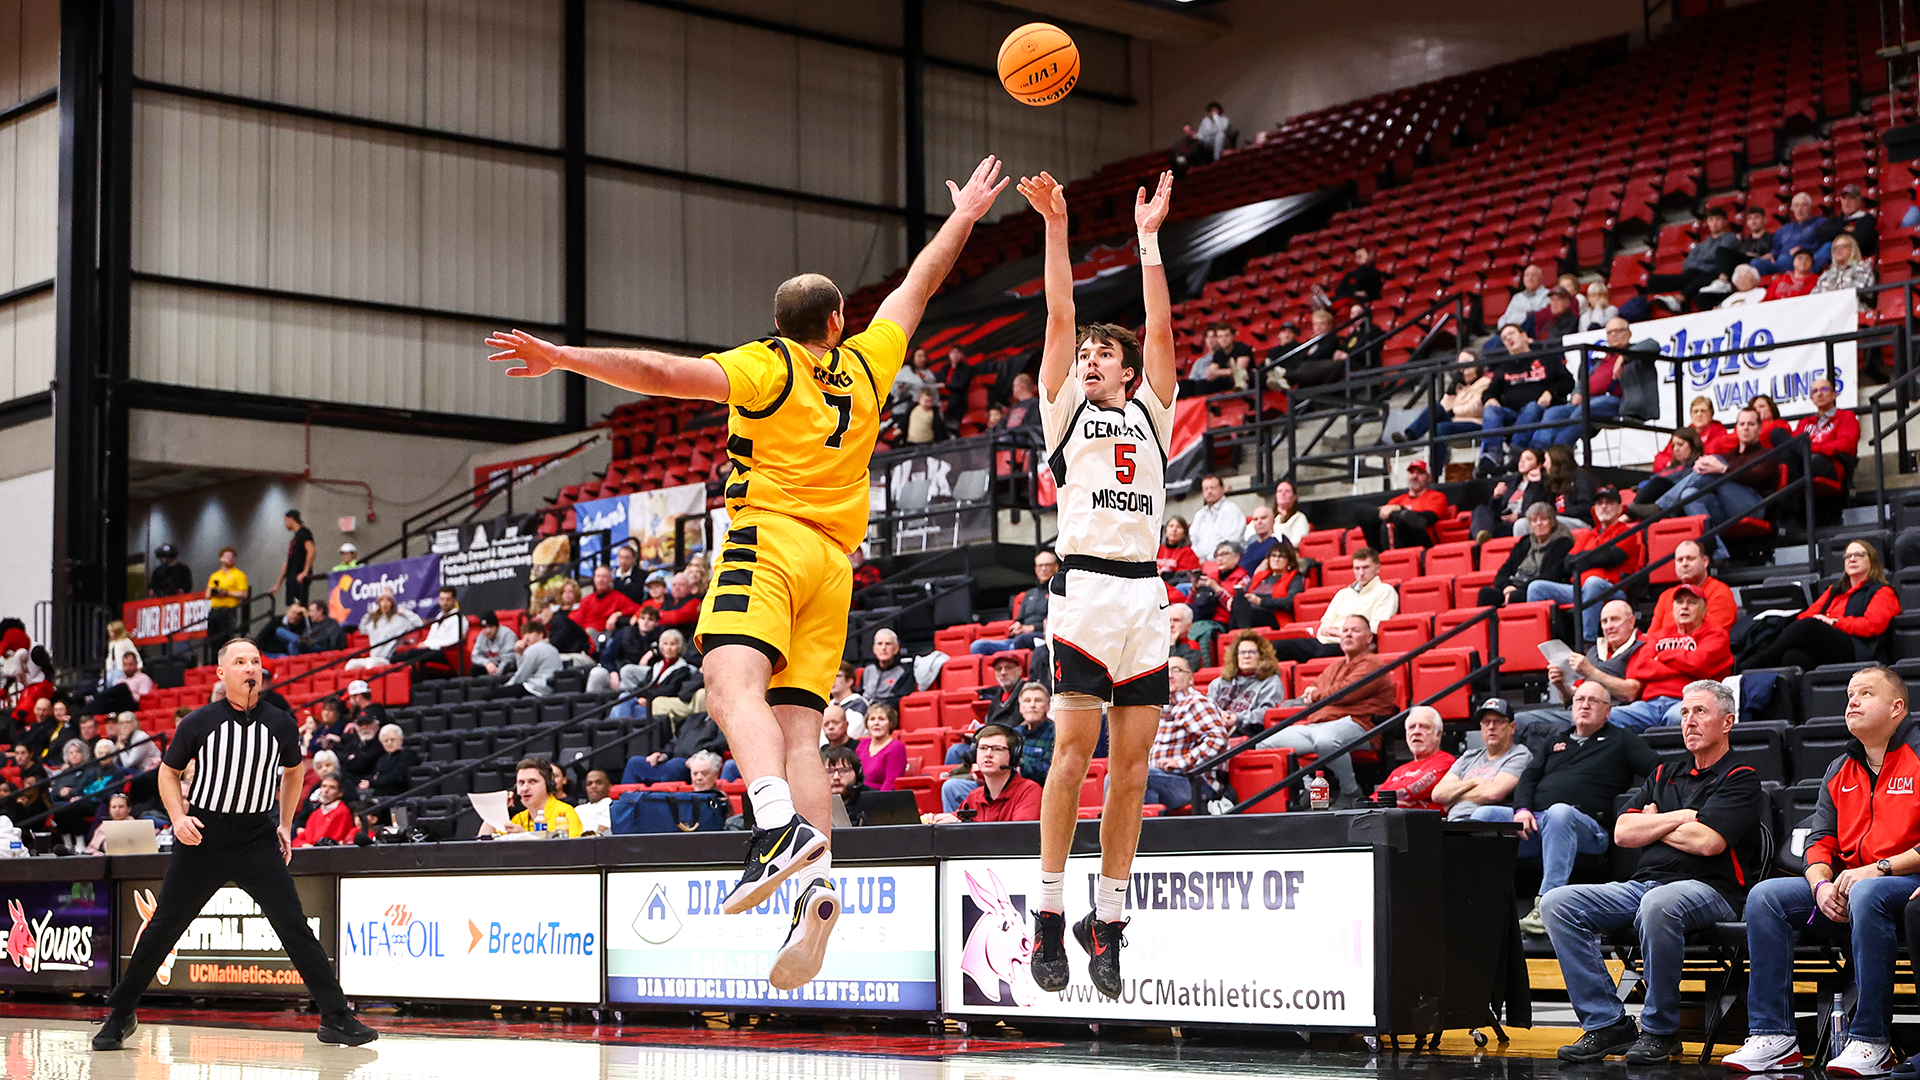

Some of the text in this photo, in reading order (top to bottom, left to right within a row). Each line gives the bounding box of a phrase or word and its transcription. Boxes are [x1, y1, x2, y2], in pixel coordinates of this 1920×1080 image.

[1713, 377, 1760, 411] VAN
[821, 391, 853, 450] 7
[1114, 443, 1136, 485] 5
[1888, 776, 1914, 790] UCM
[687, 876, 897, 915] DIAN LUB
[1087, 869, 1305, 911] UIVERSITY OF
[344, 920, 445, 958] MFA OIL
[488, 921, 595, 956] BreakTime
